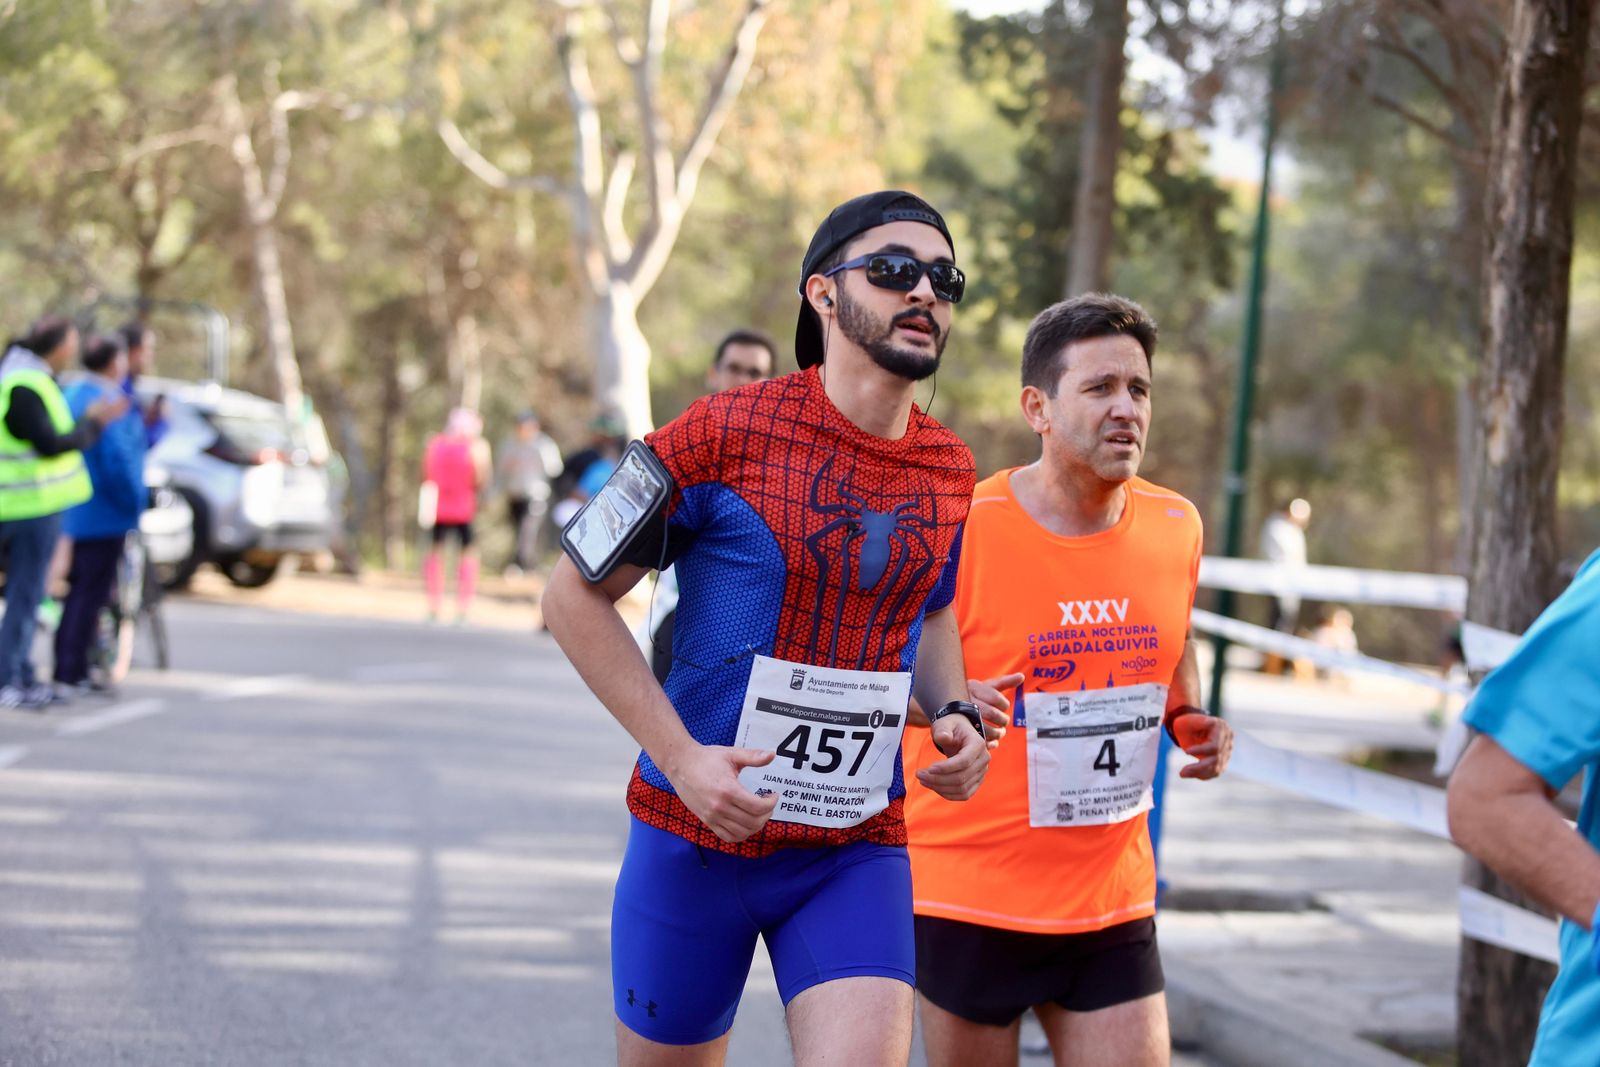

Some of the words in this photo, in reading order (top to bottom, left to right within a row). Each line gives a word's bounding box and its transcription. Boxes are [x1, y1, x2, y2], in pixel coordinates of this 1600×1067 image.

[1057, 598, 1129, 626] XXXV
[1028, 629, 1087, 644] CARRERA
[1091, 624, 1158, 638] NOCTURNA
[1039, 636, 1159, 657] GUADALQUIVIR
[808, 677, 859, 691] Ayuntamiento
[860, 682, 868, 691] de
[868, 683, 890, 693] Málaga
[771, 703, 850, 723] www.deporte.malaga.eu
[776, 724, 875, 776] 457
[1093, 739, 1120, 777] 4
[763, 774, 783, 785] JUAN
[783, 778, 815, 790] MANUEL
[816, 781, 848, 794] SÁNCHEZ
[848, 785, 870, 794] MARTÍN
[800, 792, 822, 803] MINI
[824, 795, 865, 806] MARATÓN
[1094, 796, 1111, 804] MINI
[780, 802, 808, 815] PEÑA
[810, 807, 823, 817] EL
[825, 808, 862, 819] BASTÓN
